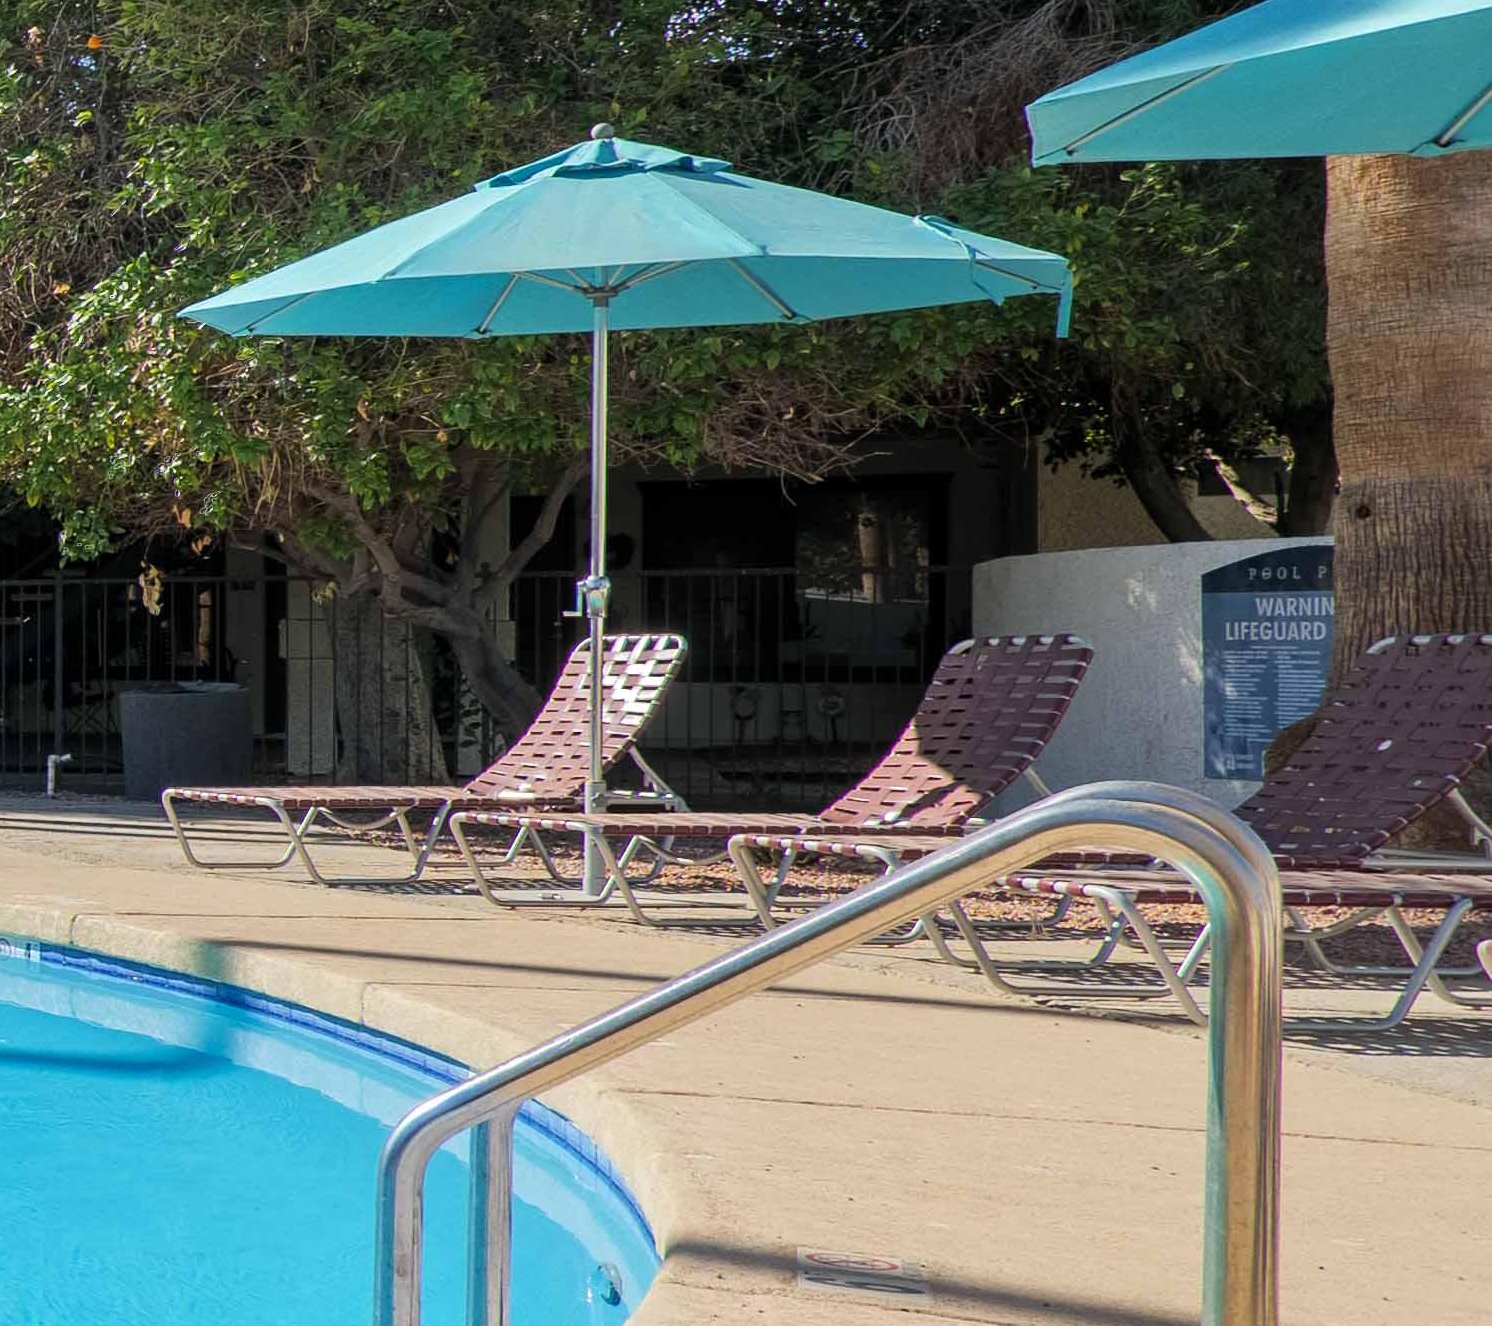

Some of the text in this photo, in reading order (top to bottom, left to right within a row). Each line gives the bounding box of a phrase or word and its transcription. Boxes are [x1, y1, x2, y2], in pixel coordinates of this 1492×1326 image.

[1248, 565, 1302, 580] POOL
[1255, 597, 1334, 616] WARNIN
[1226, 620, 1327, 641] LIFEGUARD
